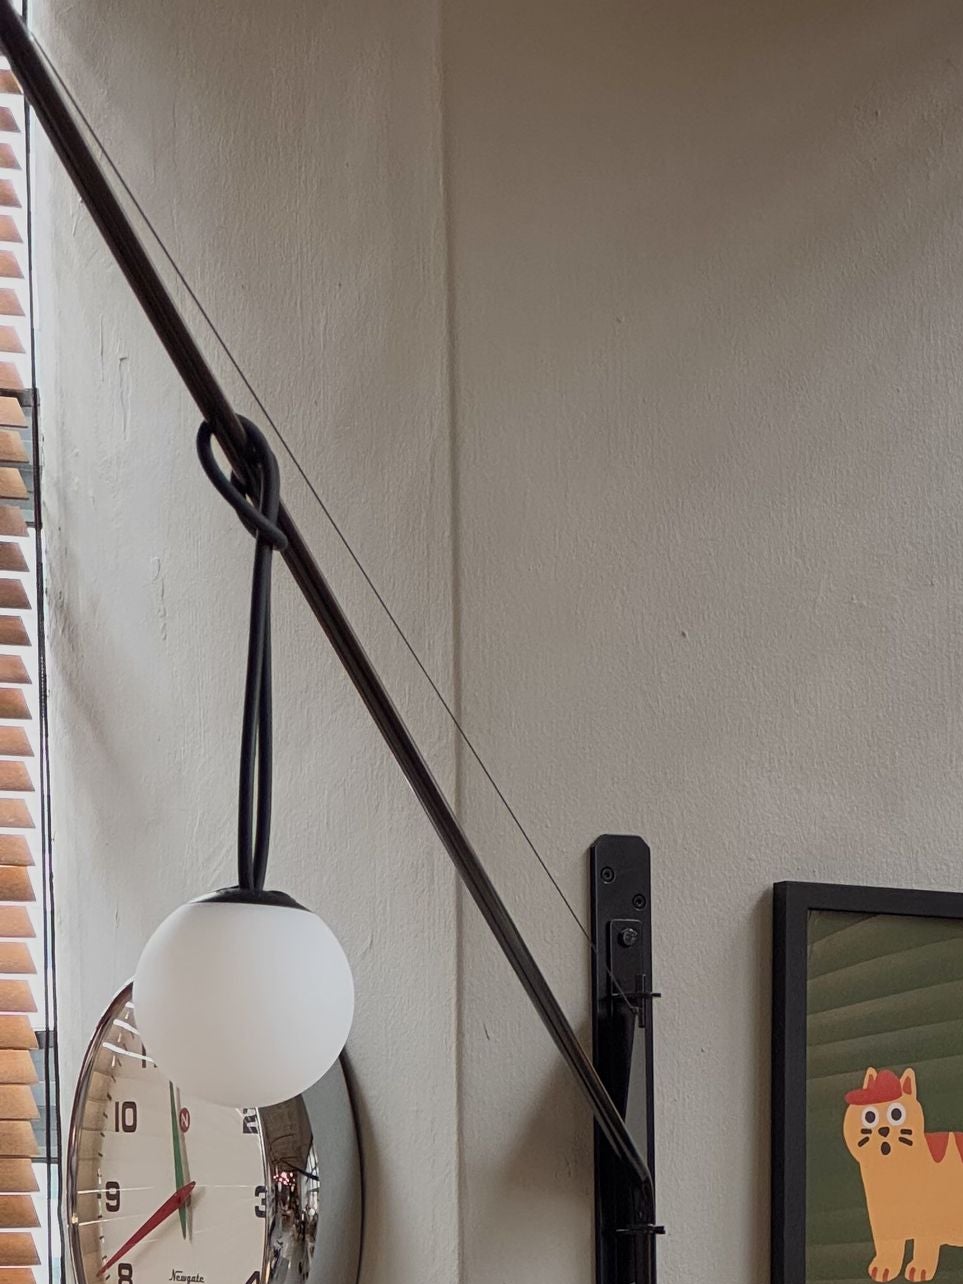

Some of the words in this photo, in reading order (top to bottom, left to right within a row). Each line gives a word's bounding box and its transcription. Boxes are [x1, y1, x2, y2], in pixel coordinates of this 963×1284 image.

[115, 1101, 137, 1133] 10
[105, 1181, 121, 1212] 9
[254, 1185, 266, 1218] 3
